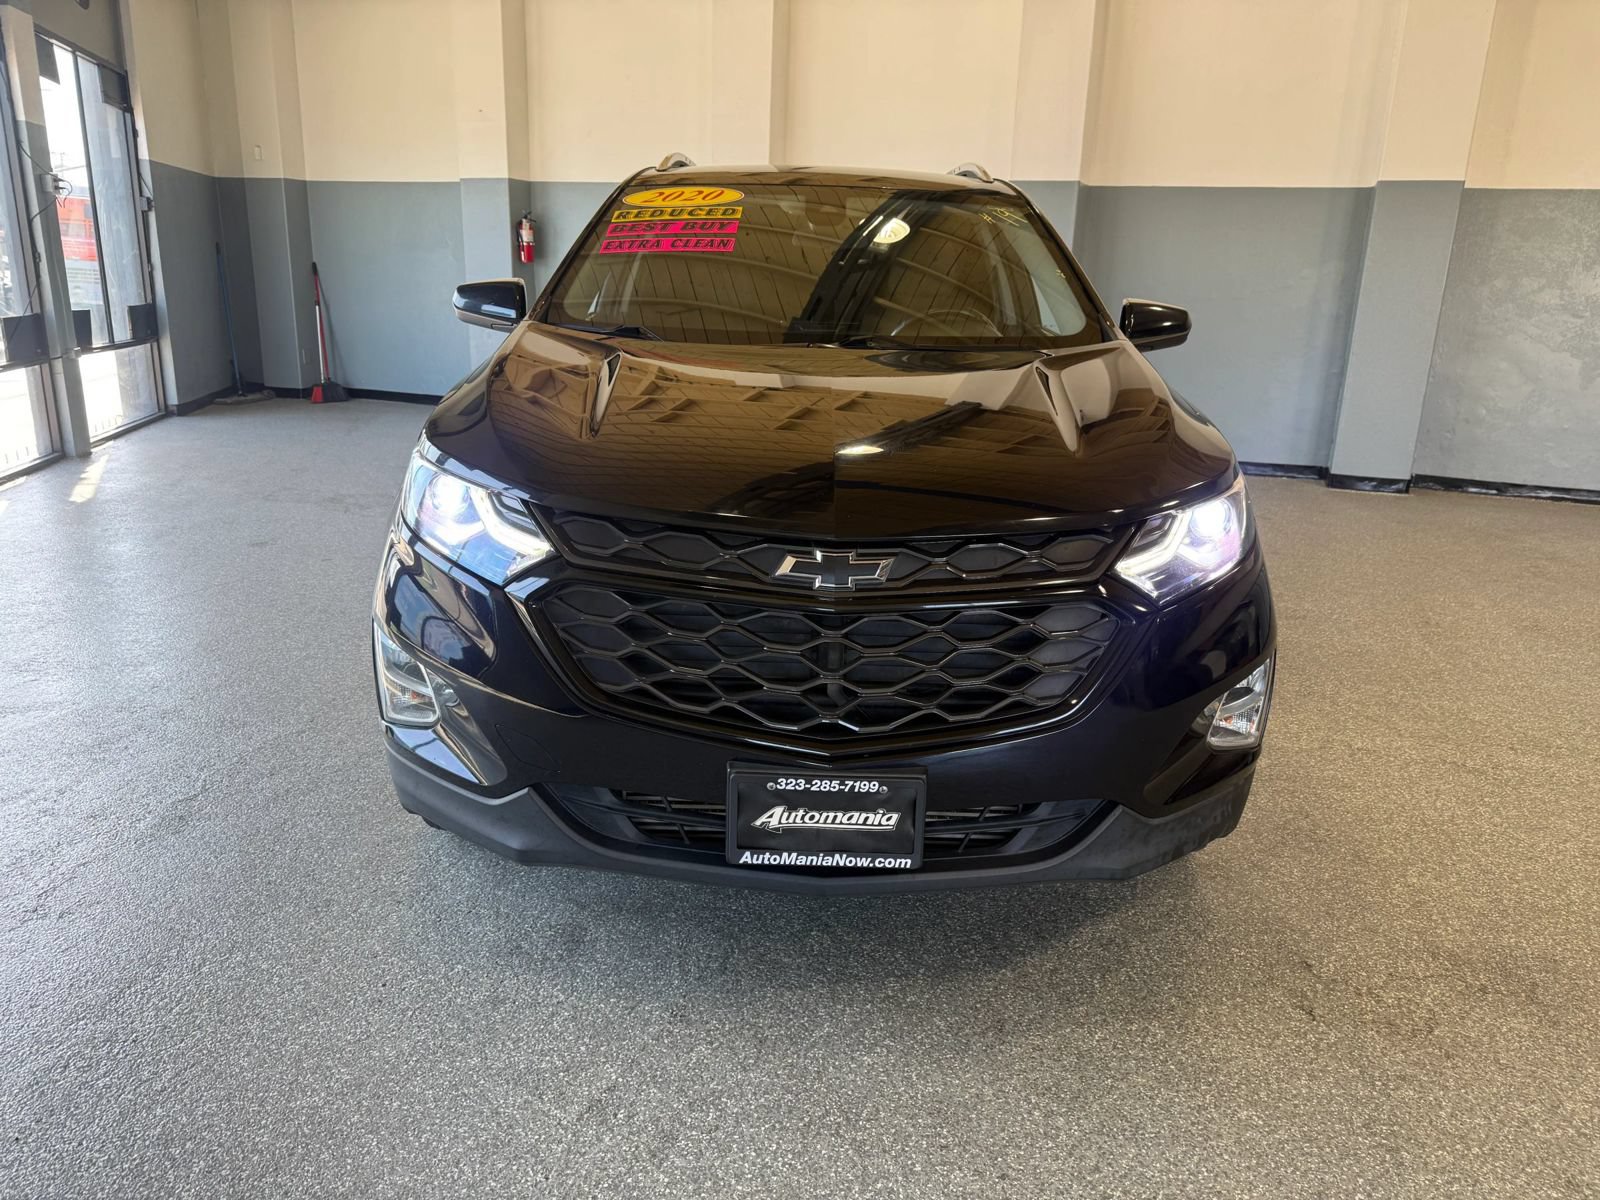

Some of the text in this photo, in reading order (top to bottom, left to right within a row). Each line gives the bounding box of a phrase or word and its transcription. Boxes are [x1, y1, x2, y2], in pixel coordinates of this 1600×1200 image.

[640, 189, 725, 204] 2020
[613, 207, 738, 221] REDUCED
[609, 220, 732, 234] BEST BUY
[604, 238, 731, 250] EXTRA CLEAN
[776, 778, 880, 793] 323-285-7199
[751, 805, 901, 833] Automania
[739, 851, 911, 868] AutoManiaNow.com
